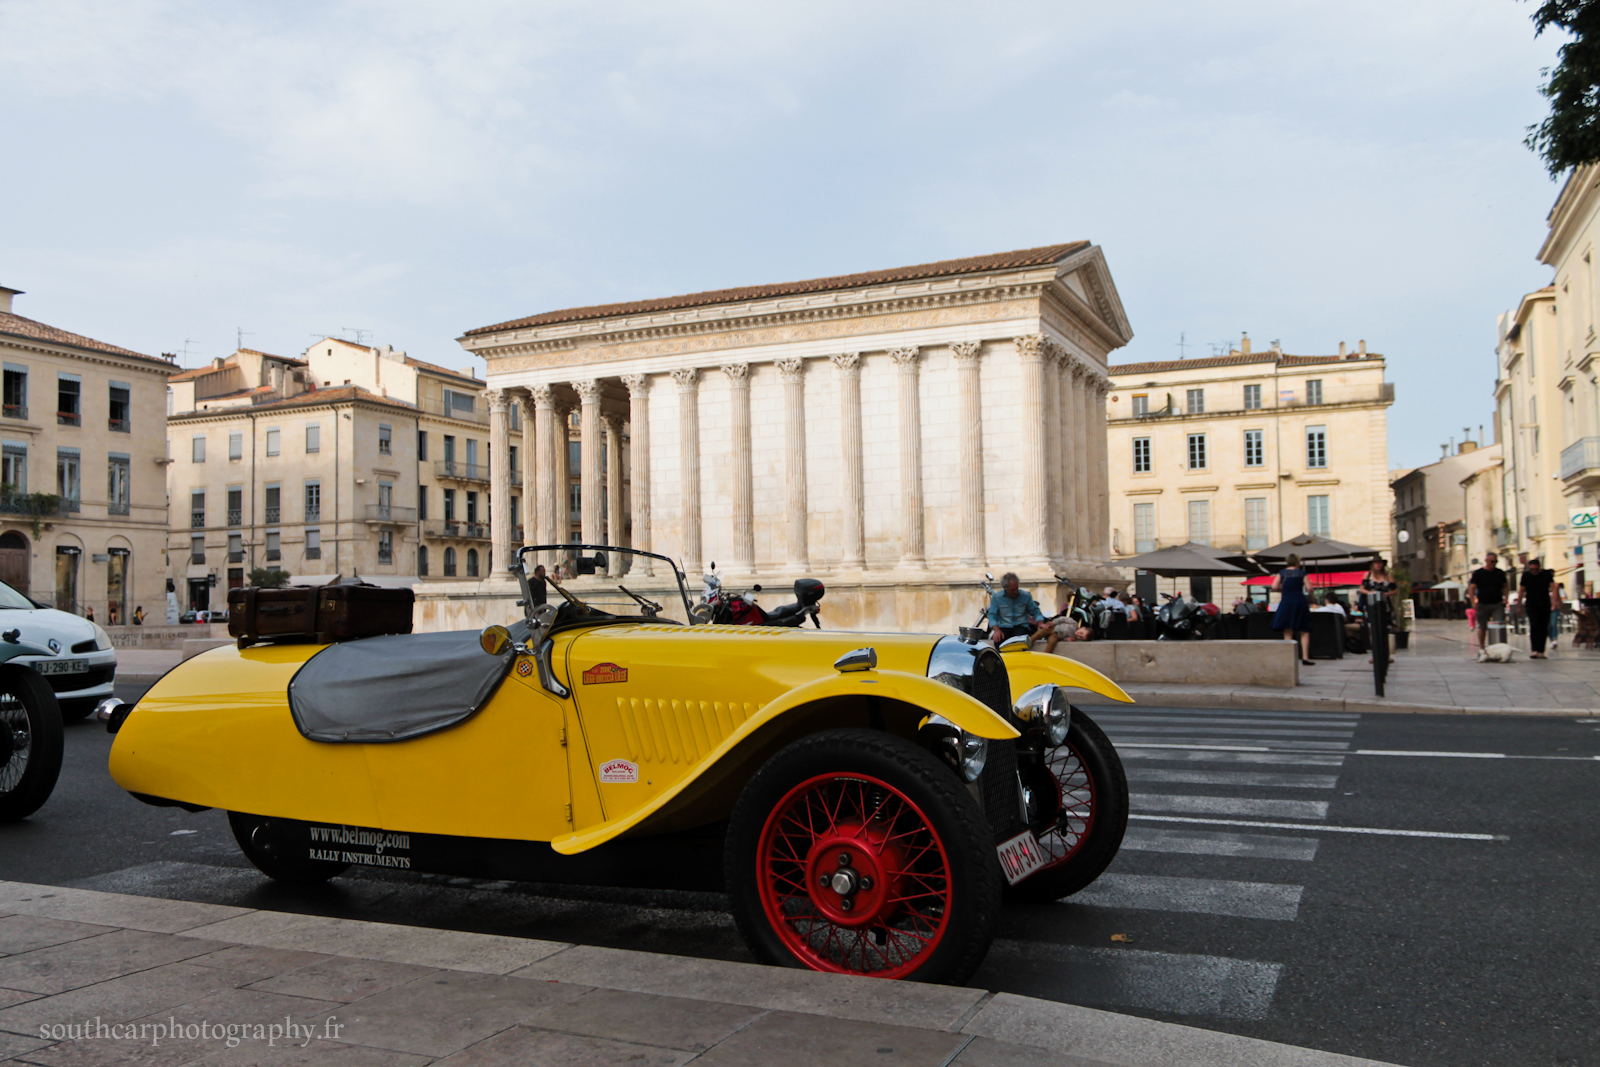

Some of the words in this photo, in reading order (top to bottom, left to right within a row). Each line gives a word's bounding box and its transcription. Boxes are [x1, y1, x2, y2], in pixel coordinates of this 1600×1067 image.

[603, 763, 635, 774] BELMOG
[309, 825, 410, 854] www.belmog.com
[309, 848, 340, 862] RALLY
[341, 851, 410, 869] INSTRUMENTS
